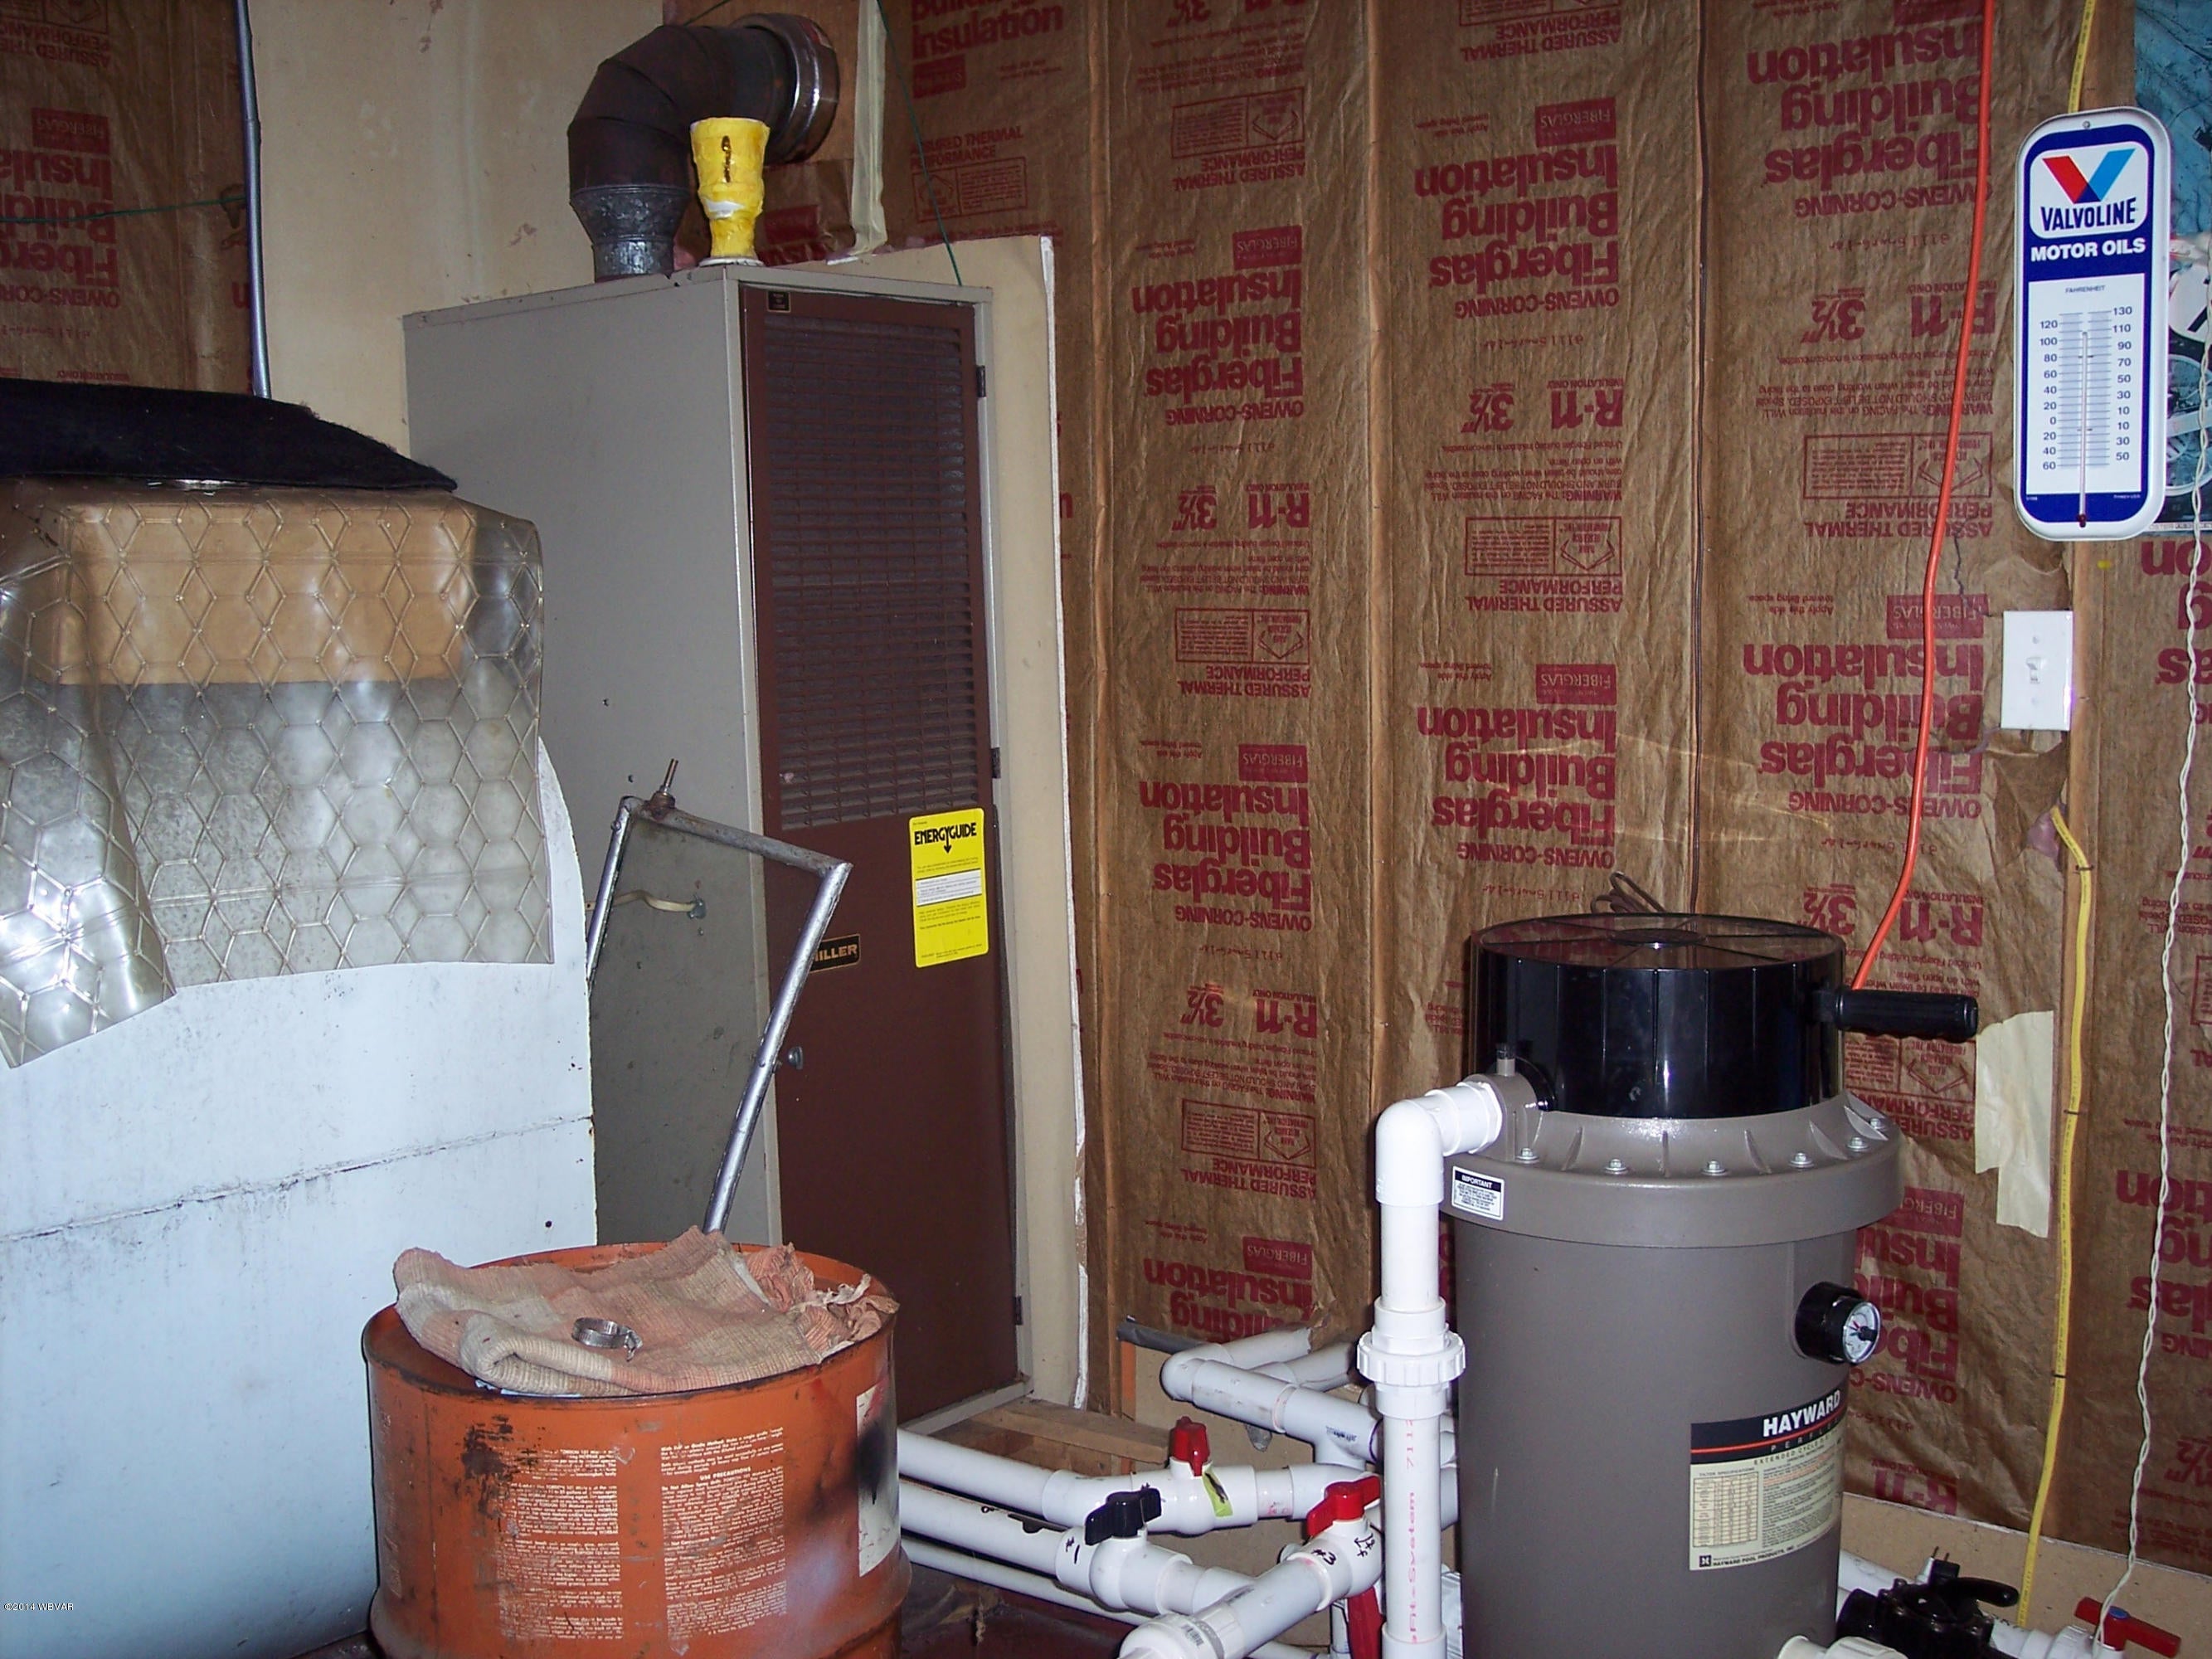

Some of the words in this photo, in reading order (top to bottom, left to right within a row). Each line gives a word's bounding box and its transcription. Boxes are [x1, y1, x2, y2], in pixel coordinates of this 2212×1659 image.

[913, 3, 1063, 59] Insulation
[1495, 11, 1622, 40] PERFORMANCE
[1542, 27, 1622, 51] ASSURED
[1460, 41, 1539, 62] THERMAL
[1540, 108, 1611, 128] FIBERGLAS
[1200, 144, 1305, 172] PERFORMANCE
[1239, 162, 1305, 183] ASSURED
[1414, 144, 1618, 198] Insulation
[1172, 171, 1237, 192] THERMAL
[1441, 192, 1618, 248] Building
[2040, 197, 2137, 232] VALVOLINE
[1236, 235, 1298, 251] FIBERGLAS
[2030, 241, 2098, 263] MOTOR
[2102, 237, 2146, 255] OILS
[1428, 240, 1619, 295] Fiberglas
[1131, 269, 1301, 315] Insulation
[2064, 285, 2106, 294] FAHRENHEIT
[1454, 288, 1620, 320] OWENS-CORNING
[2112, 306, 2132, 315] 130
[2039, 320, 2058, 329] 120
[2112, 324, 2131, 333] 110
[1155, 312, 1301, 361] Building
[2039, 337, 2058, 346] 100
[2117, 341, 2132, 350] 90
[2044, 353, 2058, 362] 80
[2117, 358, 2132, 367] 70
[1143, 354, 1303, 404] Fiberglas
[2044, 370, 2058, 379] 60
[2117, 374, 2131, 383] 50
[2044, 386, 2057, 395] 40
[2117, 390, 2131, 399] 30
[1164, 400, 1304, 426] OWENS-CORNING
[1551, 390, 1623, 431] R-11
[2043, 401, 2057, 411] 20
[2117, 406, 2130, 415] 10
[2049, 416, 2057, 426] 0
[2117, 421, 2130, 431] 10
[2043, 432, 2057, 440] 20
[2116, 436, 2130, 445] 30
[2043, 446, 2057, 455] 40
[2116, 452, 2130, 461] 50
[2043, 462, 2056, 470] 60
[1248, 494, 1310, 530] R-11
[1803, 521, 1894, 538] THERMAL
[1499, 579, 1623, 596] PERFORMANCE
[1464, 596, 1541, 612] THERMAL
[1543, 596, 1623, 613] ASSURED
[1769, 606, 1787, 615] side
[1788, 606, 1806, 615] this
[1808, 603, 1834, 616] Apply
[1892, 605, 1977, 620] FIBERLAS
[1206, 664, 1310, 682] PERFORMANCE
[1743, 643, 1984, 691] Insulation
[1177, 680, 1242, 697] THERMAL
[1244, 682, 1311, 698] ASSURED
[1540, 671, 1612, 689] FIBERGLAS
[1417, 706, 1617, 755] Insulation
[1242, 752, 1303, 767] FIBERGLAS
[1445, 741, 1616, 800] Building
[1139, 781, 1310, 827] Insulation
[1432, 789, 1616, 848] Fiberglas
[1163, 813, 1311, 870] Building
[1456, 841, 1616, 870] OWENS-CORNING
[1152, 857, 1311, 912] Fiberglas
[1174, 905, 1312, 932] OWENS-CORNING
[1899, 901, 1984, 947] R-11
[1256, 999, 1317, 1039] R-11
[1179, 1169, 1247, 1191] THERMAL
[1212, 1158, 1315, 1185] PERFORMANCE
[1461, 1174, 1494, 1189] IMPORTANT
[1250, 1178, 1315, 1199] ASSURED
[1247, 1244, 1308, 1265] FIBERGLAS
[1143, 1258, 1312, 1321] Insulation
[1762, 1389, 1841, 1438] HAYWARD
